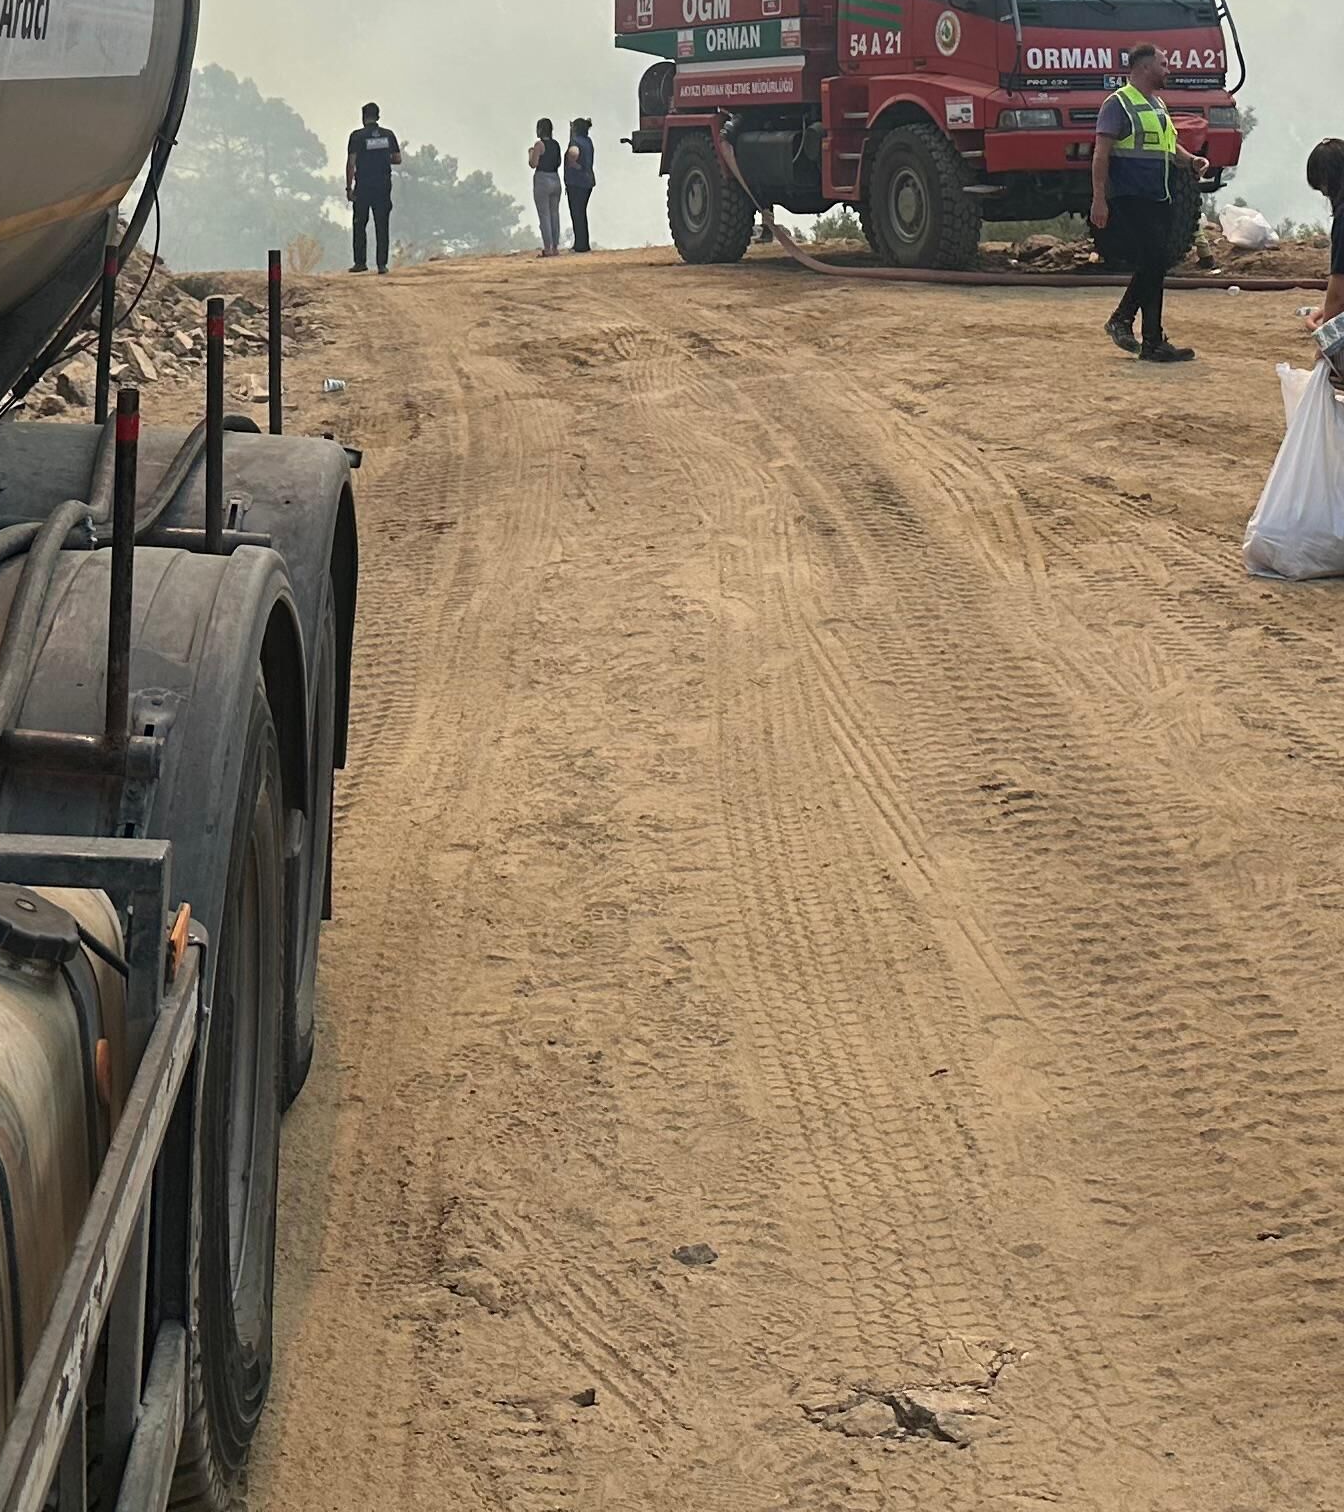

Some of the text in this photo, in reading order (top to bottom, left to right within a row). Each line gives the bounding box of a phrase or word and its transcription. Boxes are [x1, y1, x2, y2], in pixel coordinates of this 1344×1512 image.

[706, 25, 761, 52] ORMAN
[850, 31, 902, 56] 54 A 21
[1026, 48, 1113, 69] ORMAN
